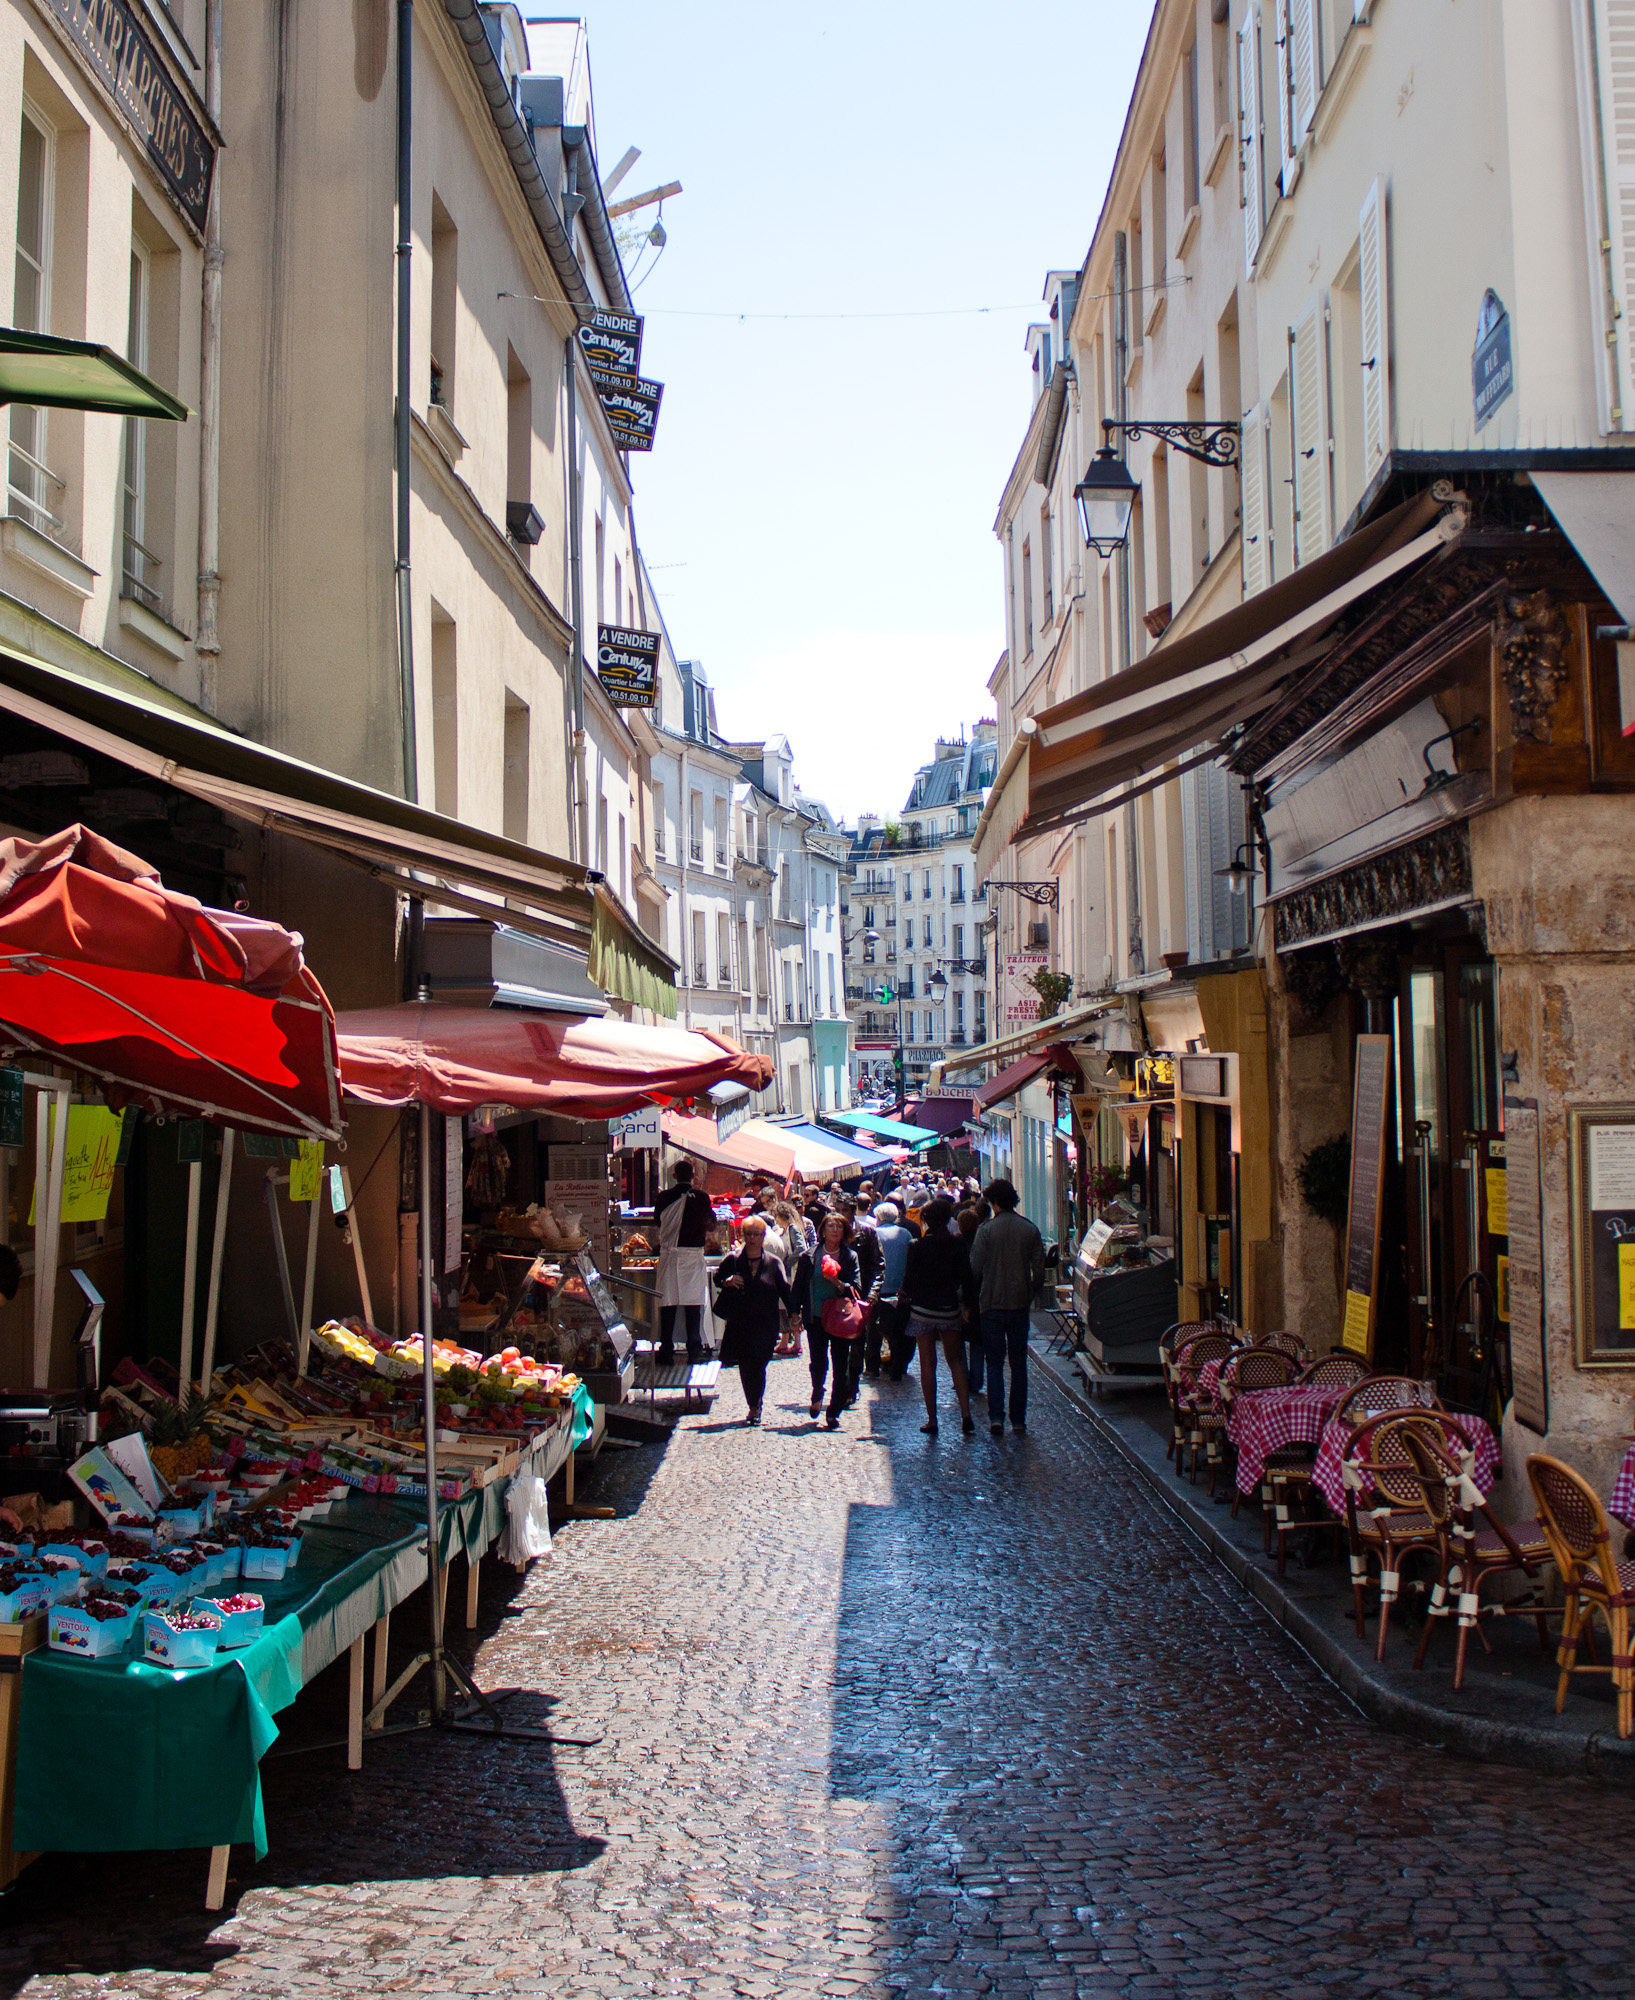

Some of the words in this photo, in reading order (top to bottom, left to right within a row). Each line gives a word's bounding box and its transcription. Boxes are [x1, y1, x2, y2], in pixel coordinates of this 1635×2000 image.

[578, 327, 627, 352] Century
[587, 357, 609, 369] uartier
[610, 361, 628, 373] Latin
[1484, 347, 1498, 379] RUE
[608, 417, 629, 429] uartier
[630, 421, 646, 434] Latin
[600, 629, 608, 642] A
[611, 631, 655, 650] VENDRE
[599, 646, 644, 668] Century
[602, 676, 627, 686] Quartier
[629, 679, 645, 689] Latin
[908, 1050, 946, 1061] PHARMACIE
[926, 1087, 974, 1097] BOUCHE
[321, 1465, 361, 1486] zalama
[149, 1587, 173, 1596] VENTOUX
[57, 1620, 90, 1633] VENTOUX
[148, 1629, 170, 1641] VENTOUX
